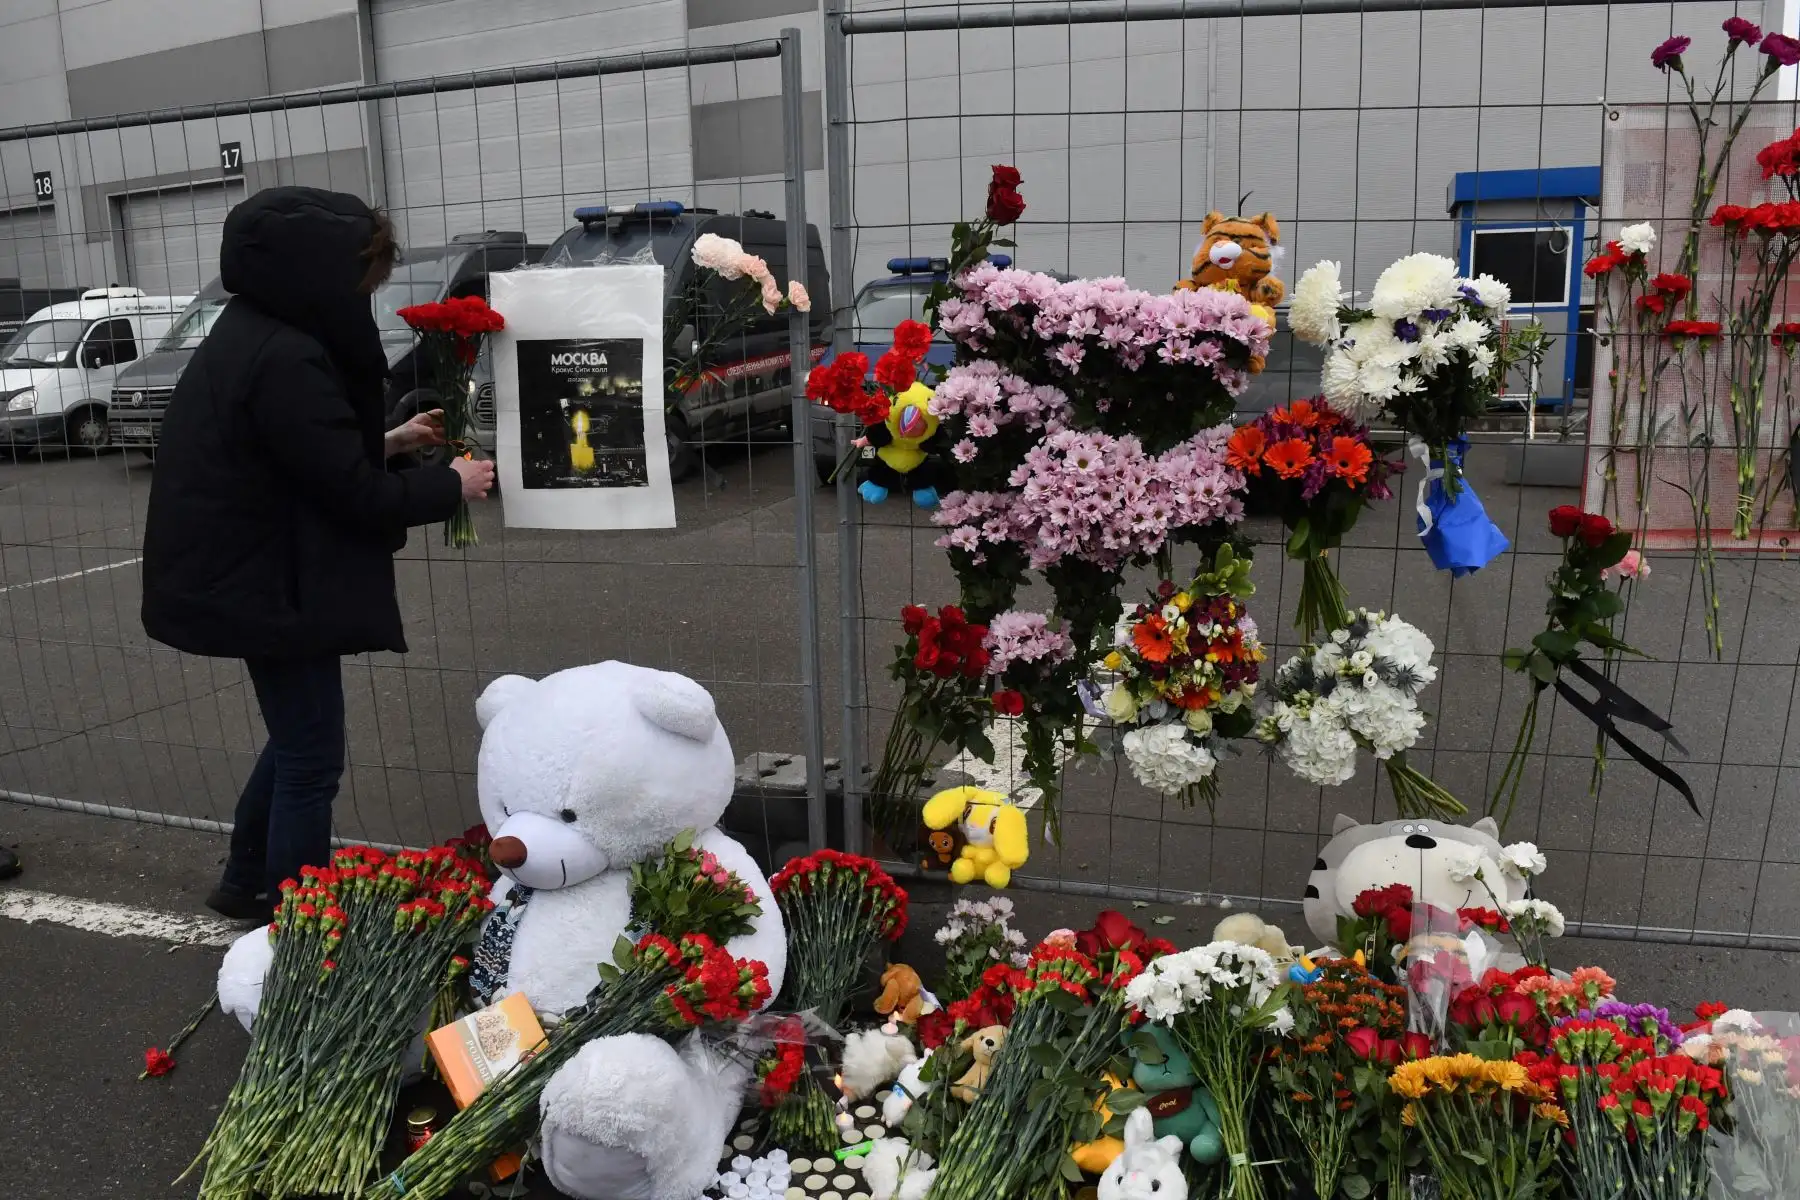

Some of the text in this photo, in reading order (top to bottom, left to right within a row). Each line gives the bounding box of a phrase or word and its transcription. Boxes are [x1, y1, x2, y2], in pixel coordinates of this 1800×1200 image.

[221, 148, 240, 169] 17
[35, 177, 52, 196] 18
[551, 352, 608, 366] МОСКВА
[551, 366, 574, 374] Крокус
